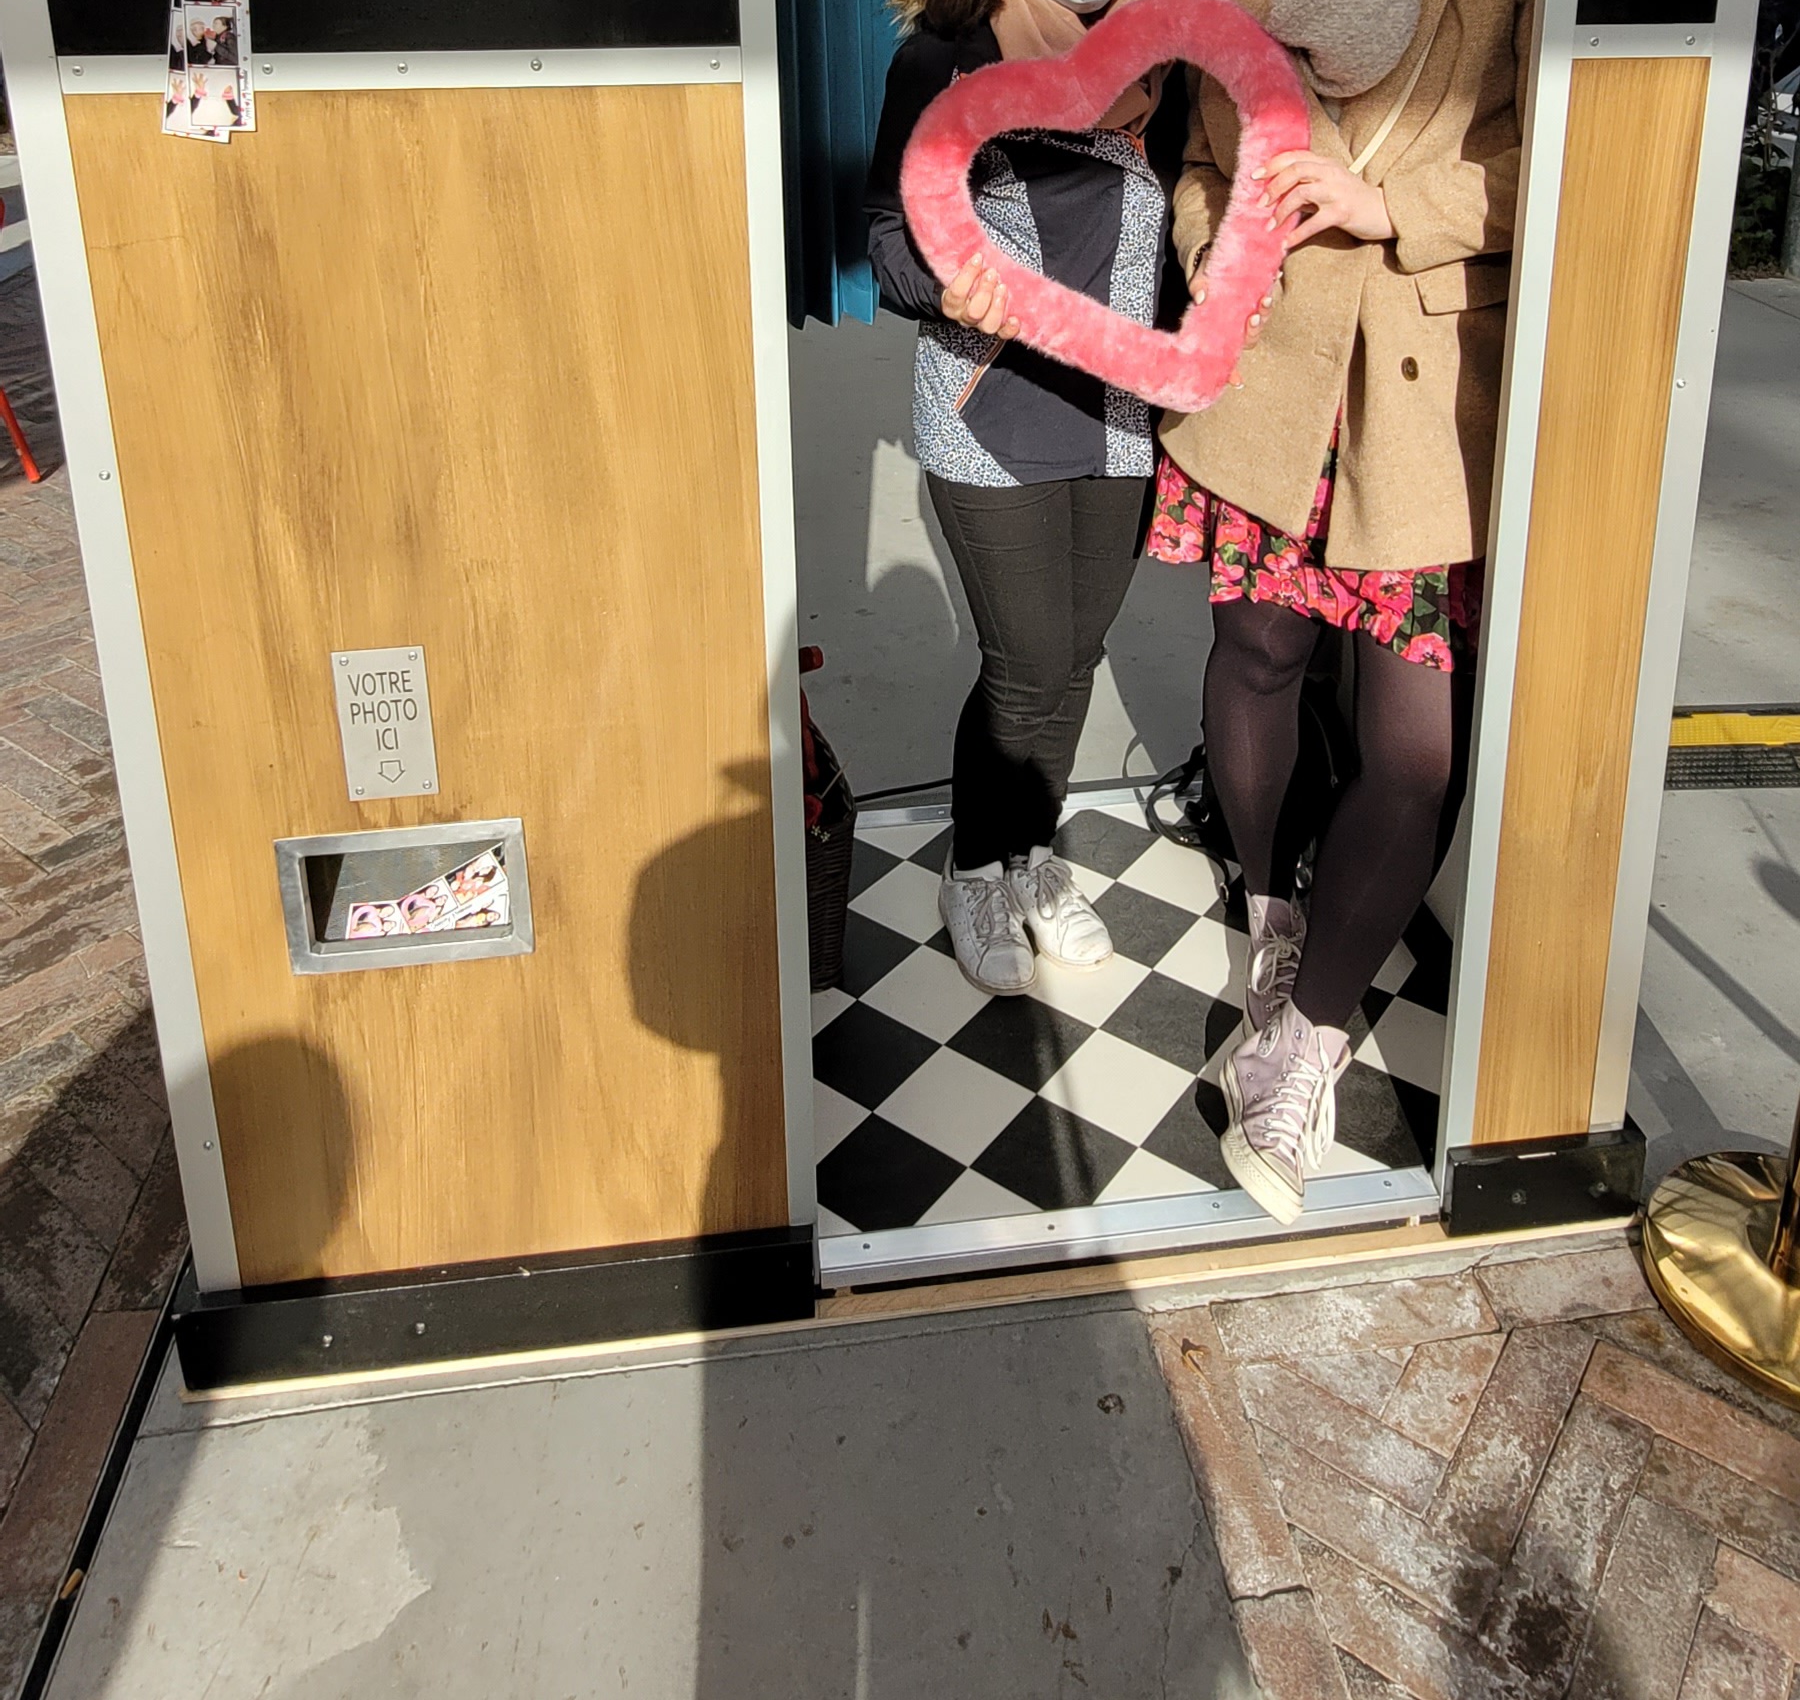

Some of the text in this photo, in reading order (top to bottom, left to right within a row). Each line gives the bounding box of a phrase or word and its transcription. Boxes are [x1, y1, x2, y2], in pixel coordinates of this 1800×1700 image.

[347, 670, 413, 696] VOTRE
[350, 698, 418, 725] PHOTO
[376, 727, 399, 751] ICI
